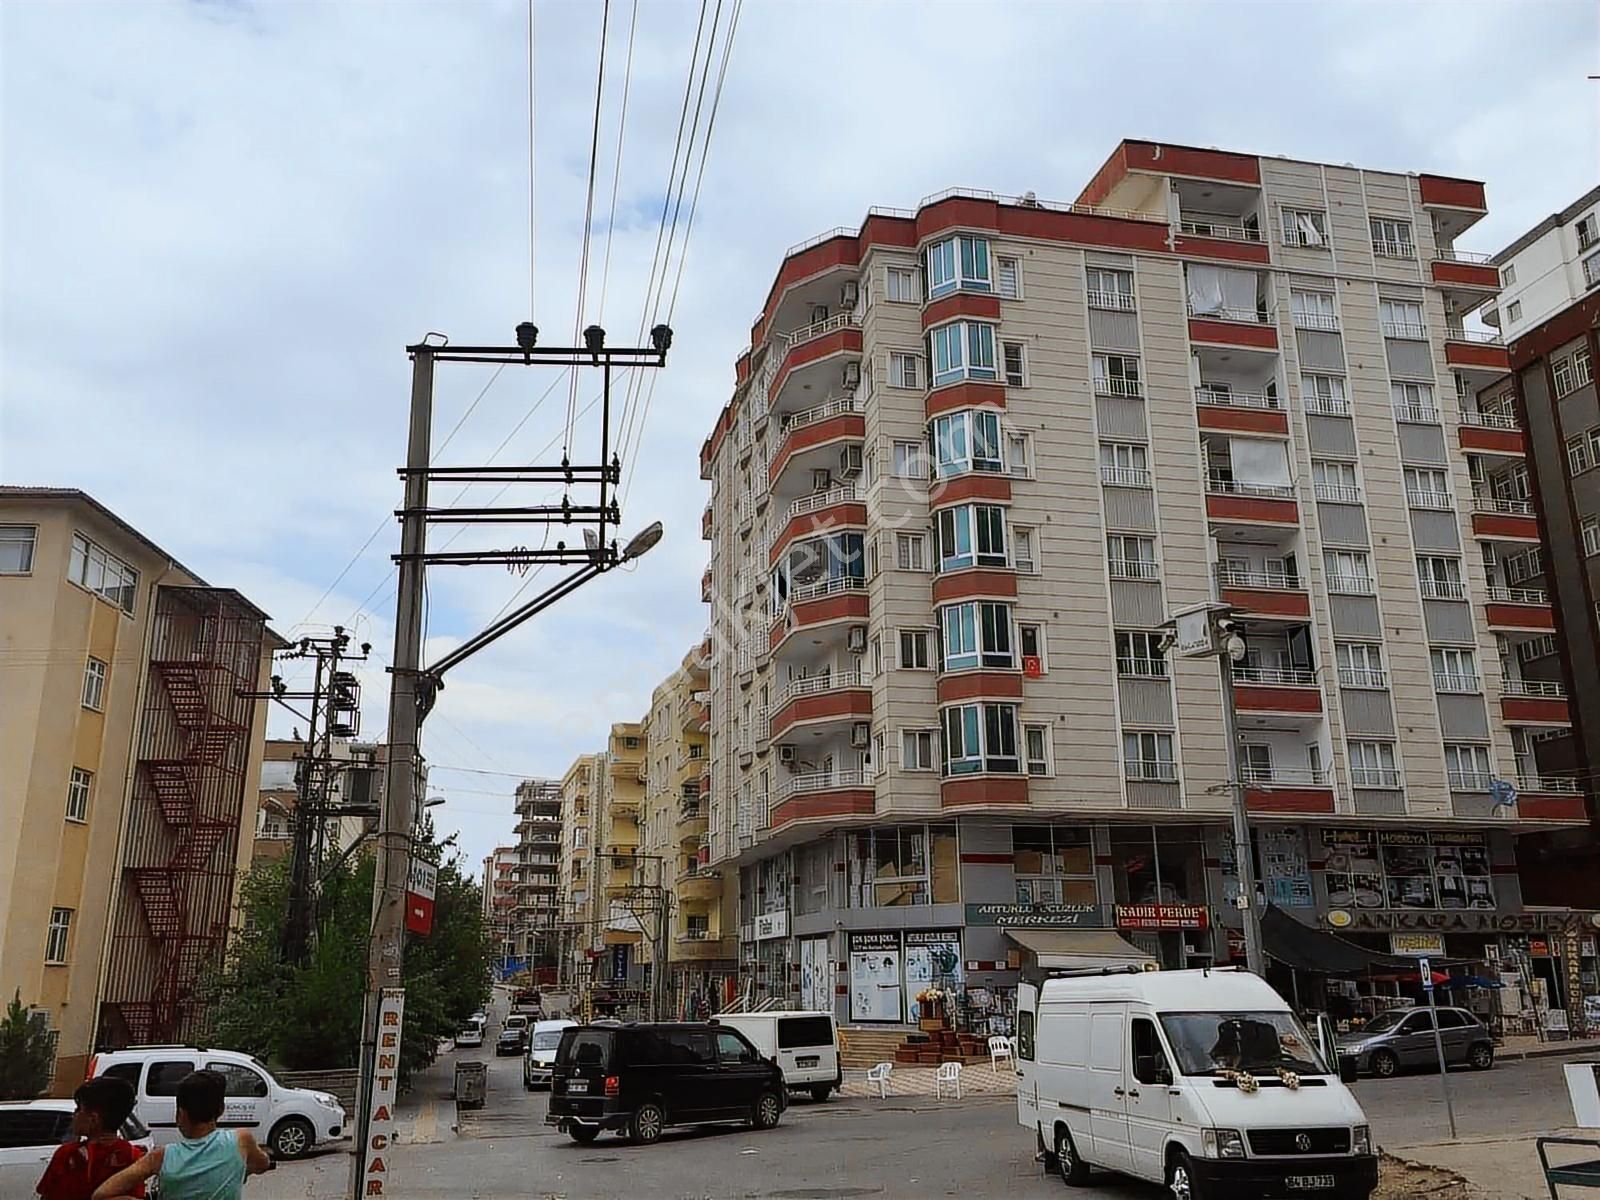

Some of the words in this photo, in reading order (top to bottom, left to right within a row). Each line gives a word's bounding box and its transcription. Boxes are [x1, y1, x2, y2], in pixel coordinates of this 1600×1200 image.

[1353, 914, 1468, 930] ANKARA
[378, 1011, 399, 1091] RENT
[373, 1105, 391, 1121] A
[366, 1134, 388, 1196] CAR
